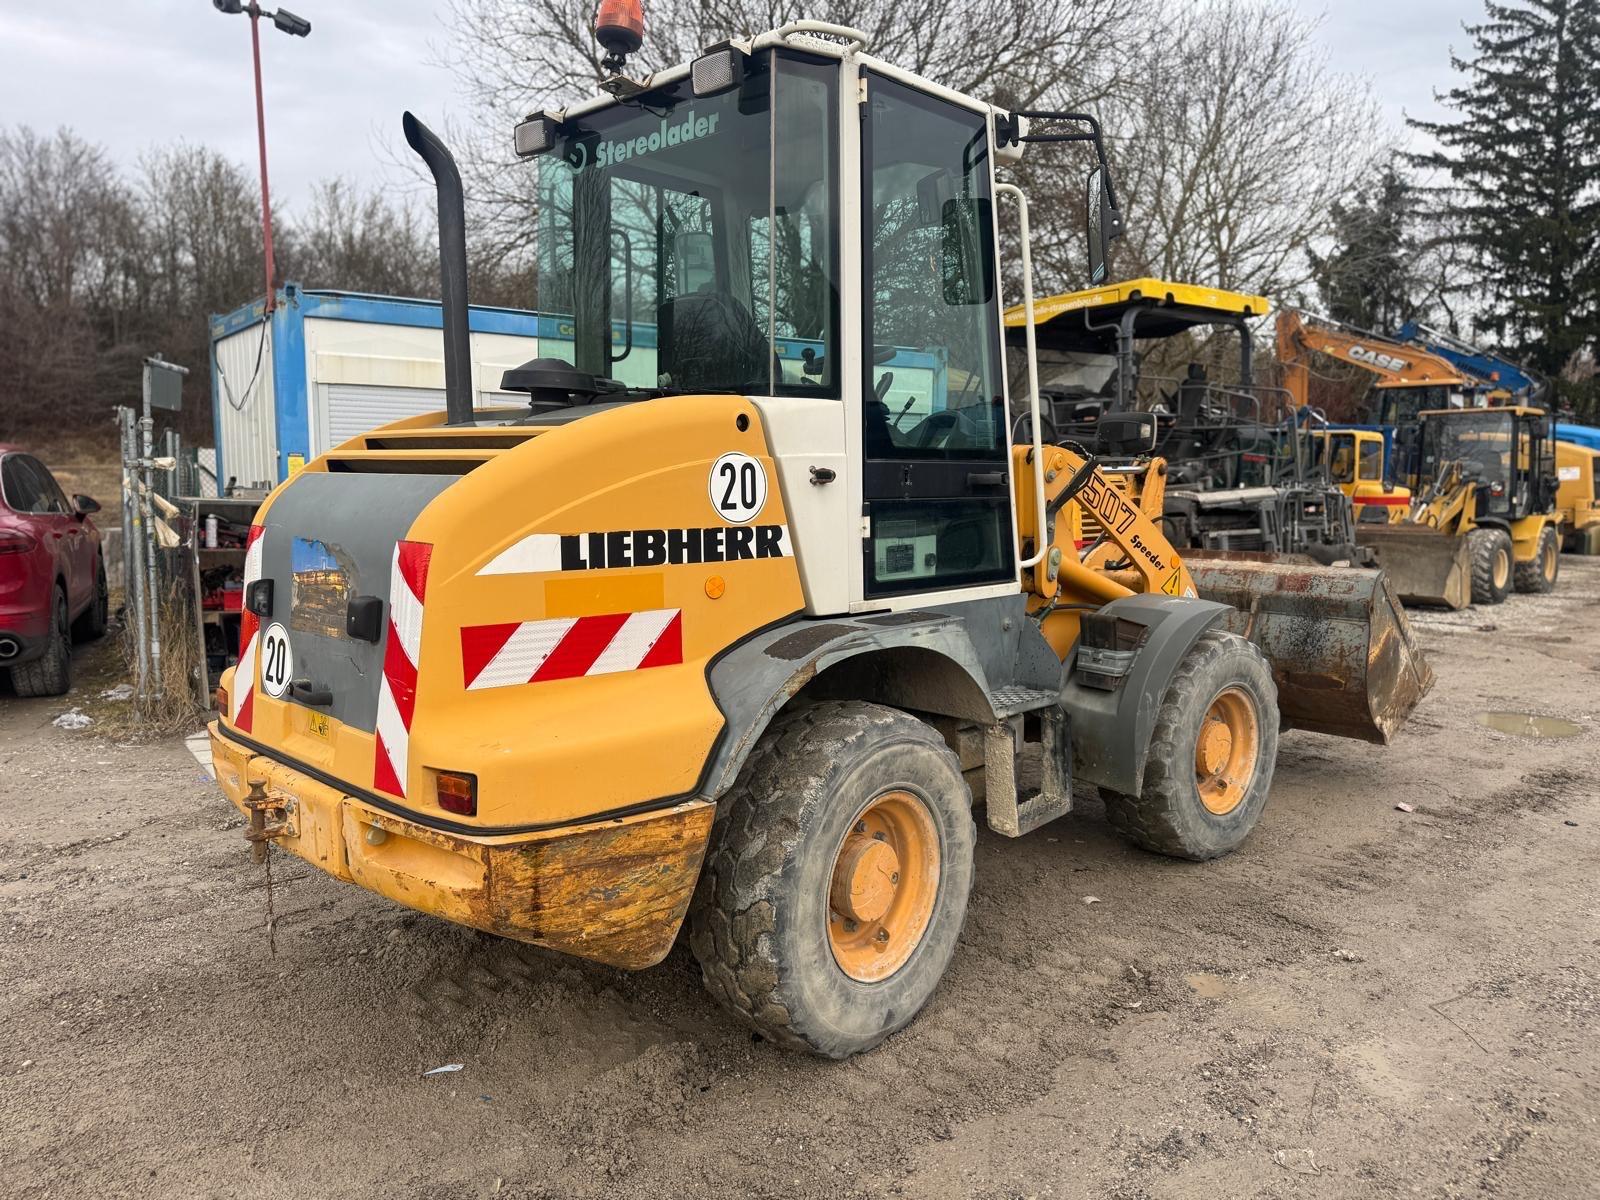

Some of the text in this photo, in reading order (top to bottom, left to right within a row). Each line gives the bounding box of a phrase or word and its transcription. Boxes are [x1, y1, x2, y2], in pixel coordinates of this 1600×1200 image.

[595, 110, 719, 168] Stereolader
[1348, 345, 1406, 372] CASE
[719, 462, 757, 511] 20
[560, 524, 784, 572] LIEBHERR
[1129, 535, 1165, 571] Speeder
[265, 635, 286, 686] 20
